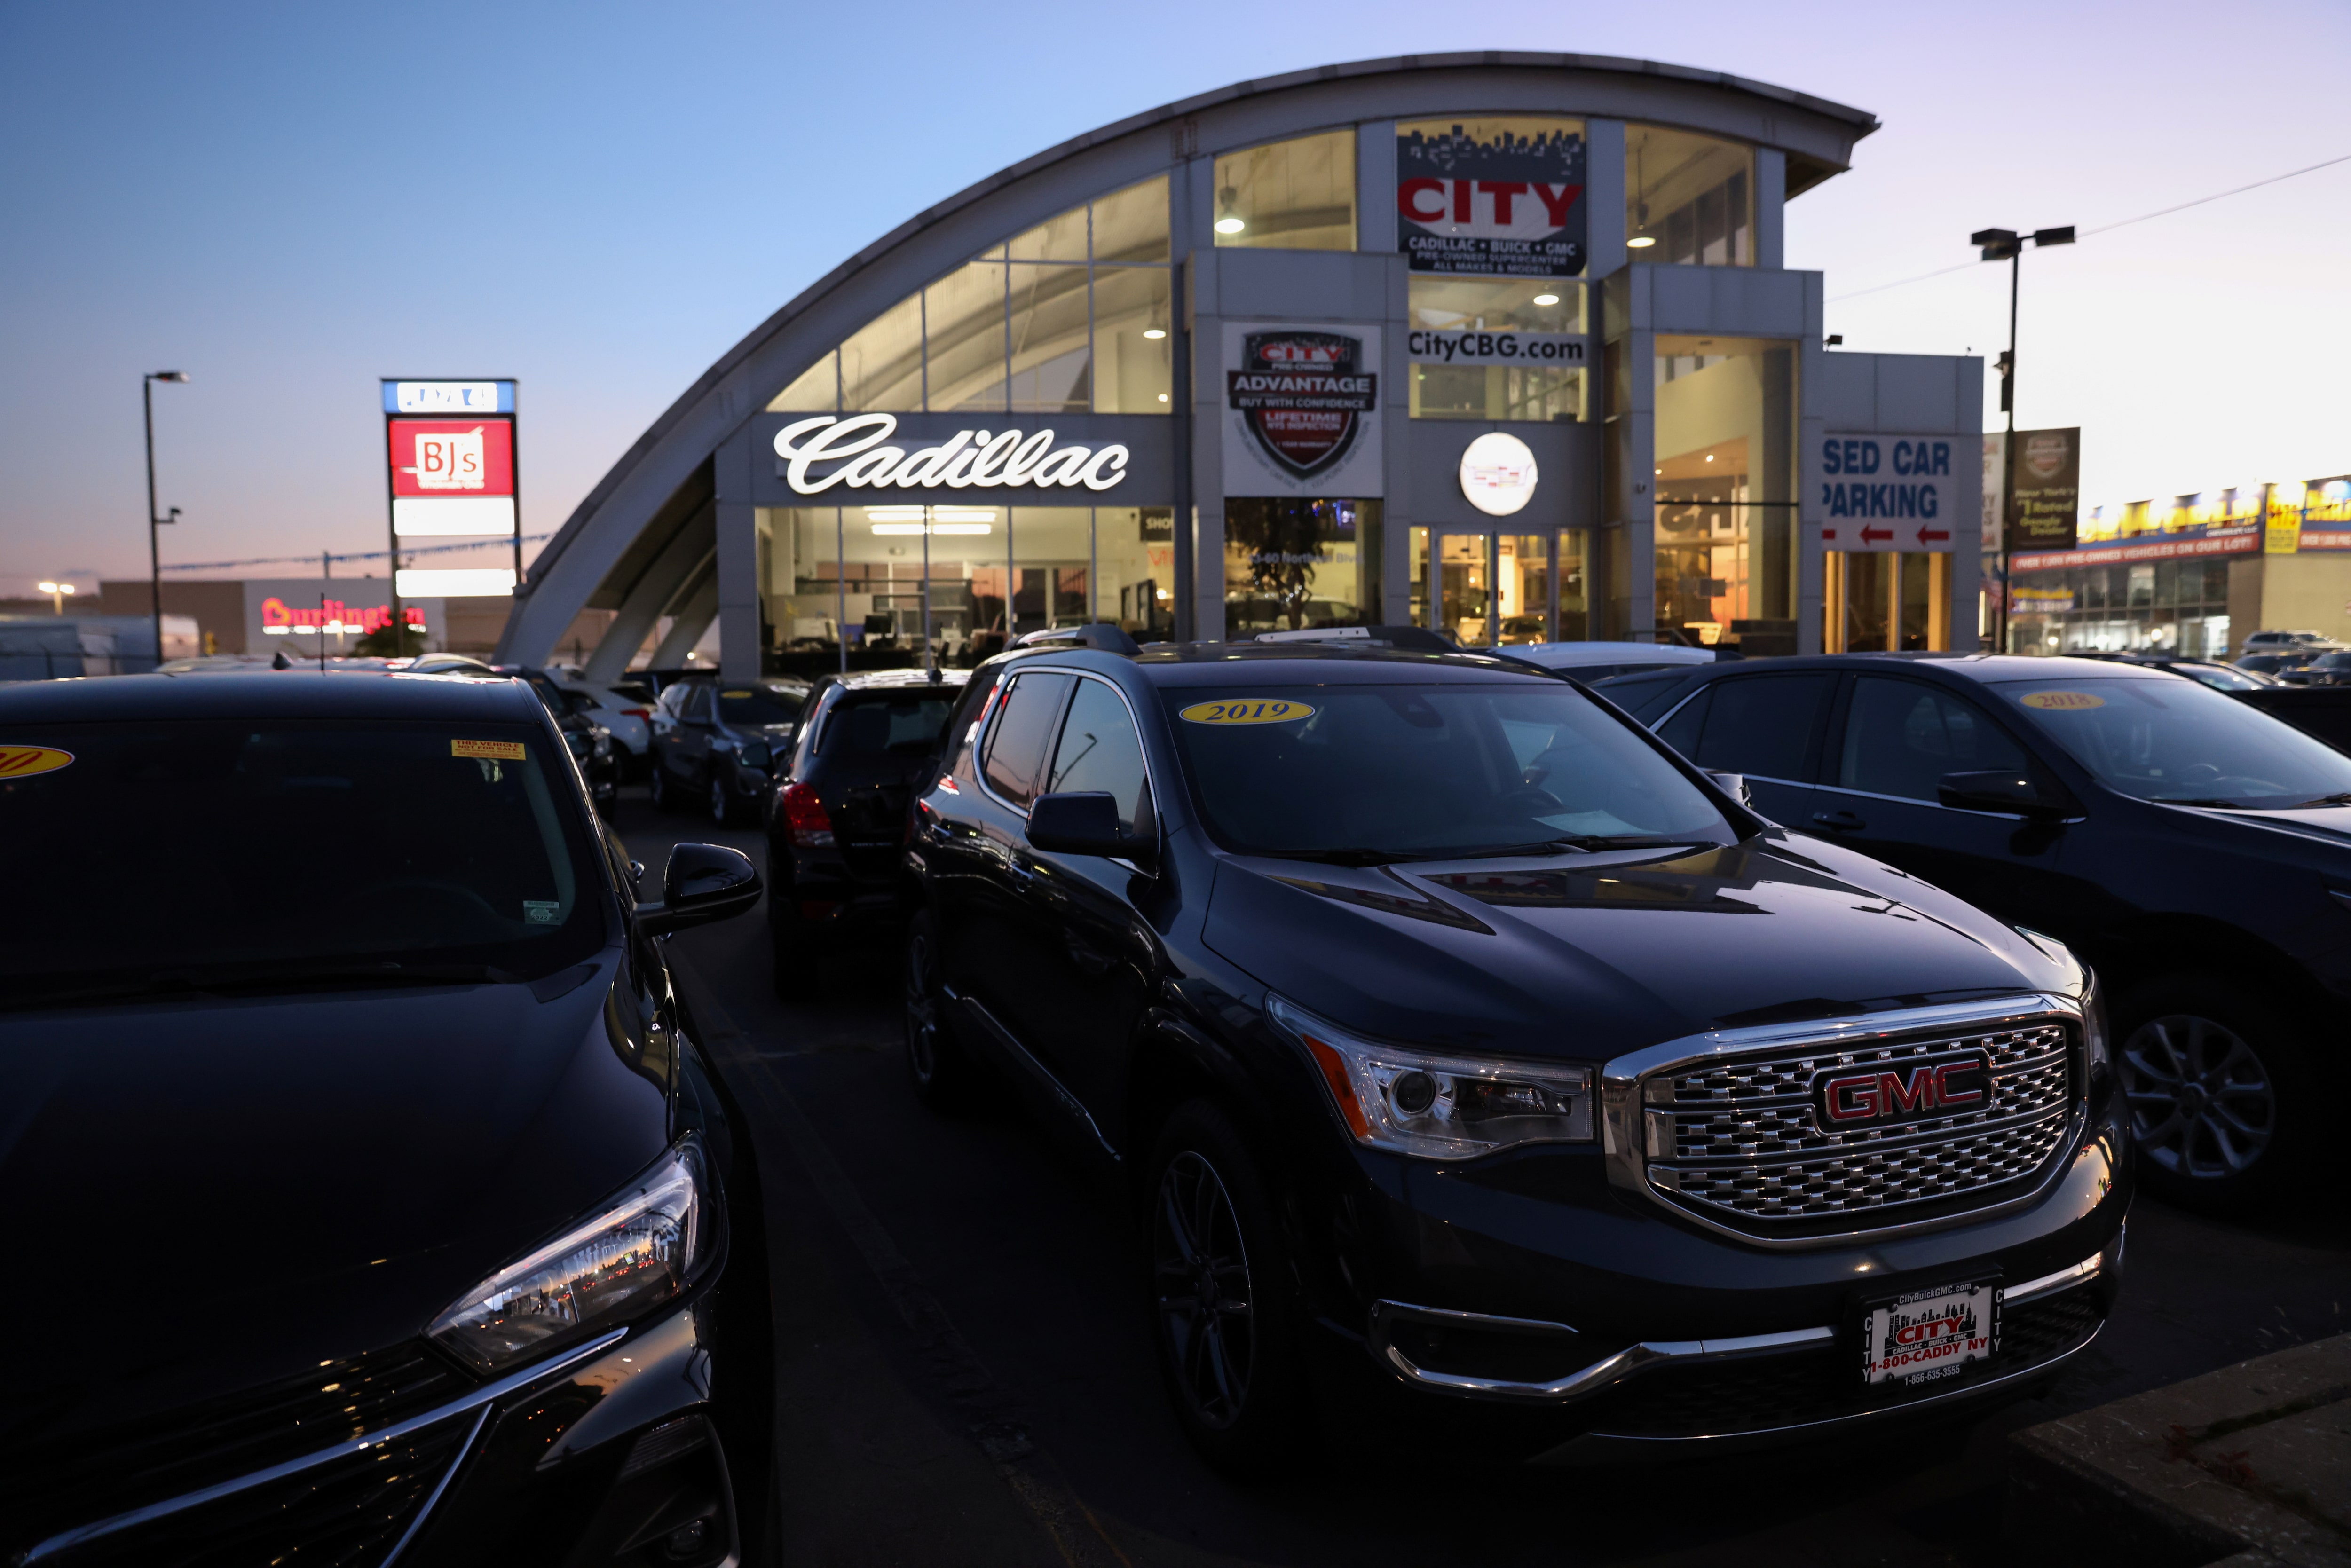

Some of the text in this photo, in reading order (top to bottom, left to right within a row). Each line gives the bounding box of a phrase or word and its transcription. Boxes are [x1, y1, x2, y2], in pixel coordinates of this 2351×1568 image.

[1398, 177, 1583, 227] CITY
[1409, 237, 1577, 256] CADILLAC BUICK GMC
[1260, 344, 1344, 362] CITY
[1409, 332, 1582, 362] CityCBG.com
[1234, 376, 1371, 393] ADVANTAGE
[1239, 398, 1365, 409] BUY WITH CONFIDENCE
[1265, 412, 1341, 422] LIFETIME
[773, 413, 1129, 495] Cadillac
[1893, 441, 1950, 476] CAR
[2124, 544, 2175, 559] VEHICLES
[2177, 543, 2194, 554] ON
[2196, 539, 2222, 552] OUR
[262, 597, 426, 635] Burlingtn
[2037, 694, 2091, 707] 2018
[1205, 703, 1290, 721] 2019
[1824, 1059, 1982, 1123] GMC
[1899, 1283, 1972, 1305] CityBuickGMC.com
[1897, 1316, 1964, 1345] CITY
[1870, 1337, 1988, 1372] 1-800-CADDY NY
[1893, 1343, 1922, 1355] CADILLAC
[1928, 1338, 1947, 1347] BUICK
[1905, 1364, 1960, 1386] 1-866-635-3555
